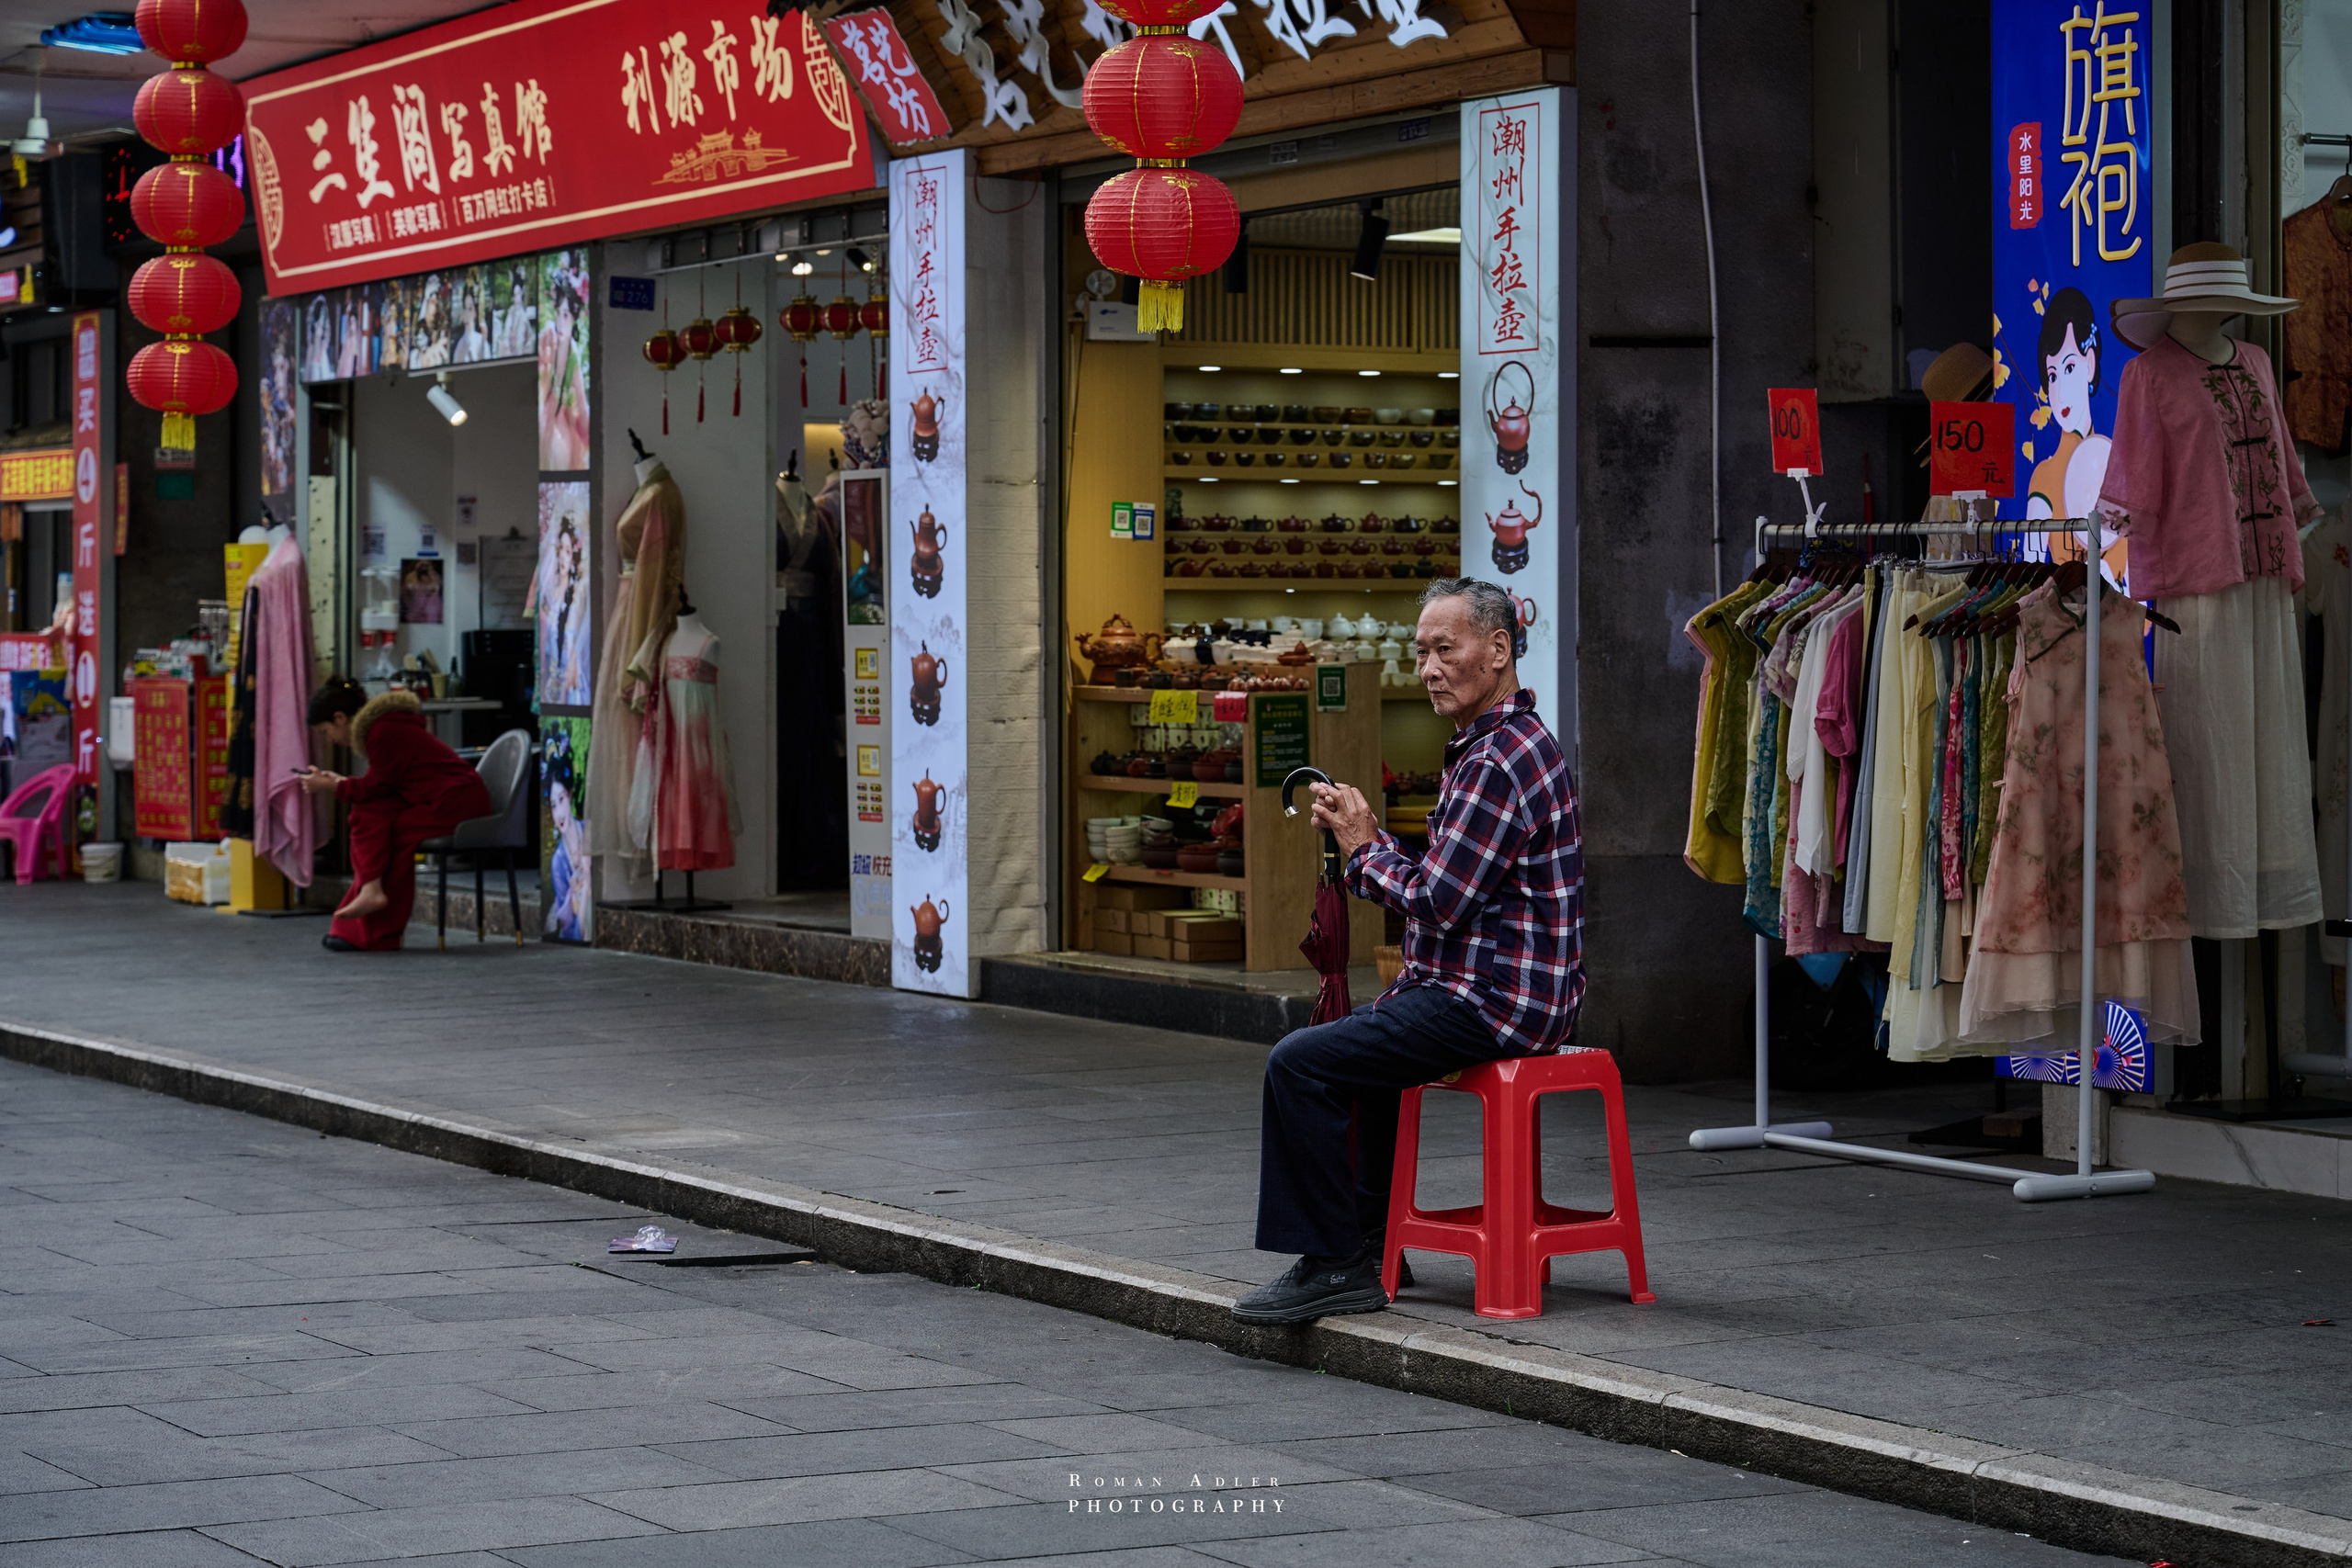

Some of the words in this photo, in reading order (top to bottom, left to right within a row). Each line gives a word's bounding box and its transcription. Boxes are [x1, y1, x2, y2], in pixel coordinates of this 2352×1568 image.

[621, 15, 794, 135] 利源市场
[2060, 0, 2142, 266] 旗袍
[2018, 131, 2032, 220] 水里阳光
[459, 177, 548, 224] 百万网红打卡店
[1772, 406, 1801, 440] 100
[1937, 420, 1984, 453] 150
[1804, 445, 1816, 466] 元
[1981, 462, 2006, 484] 元
